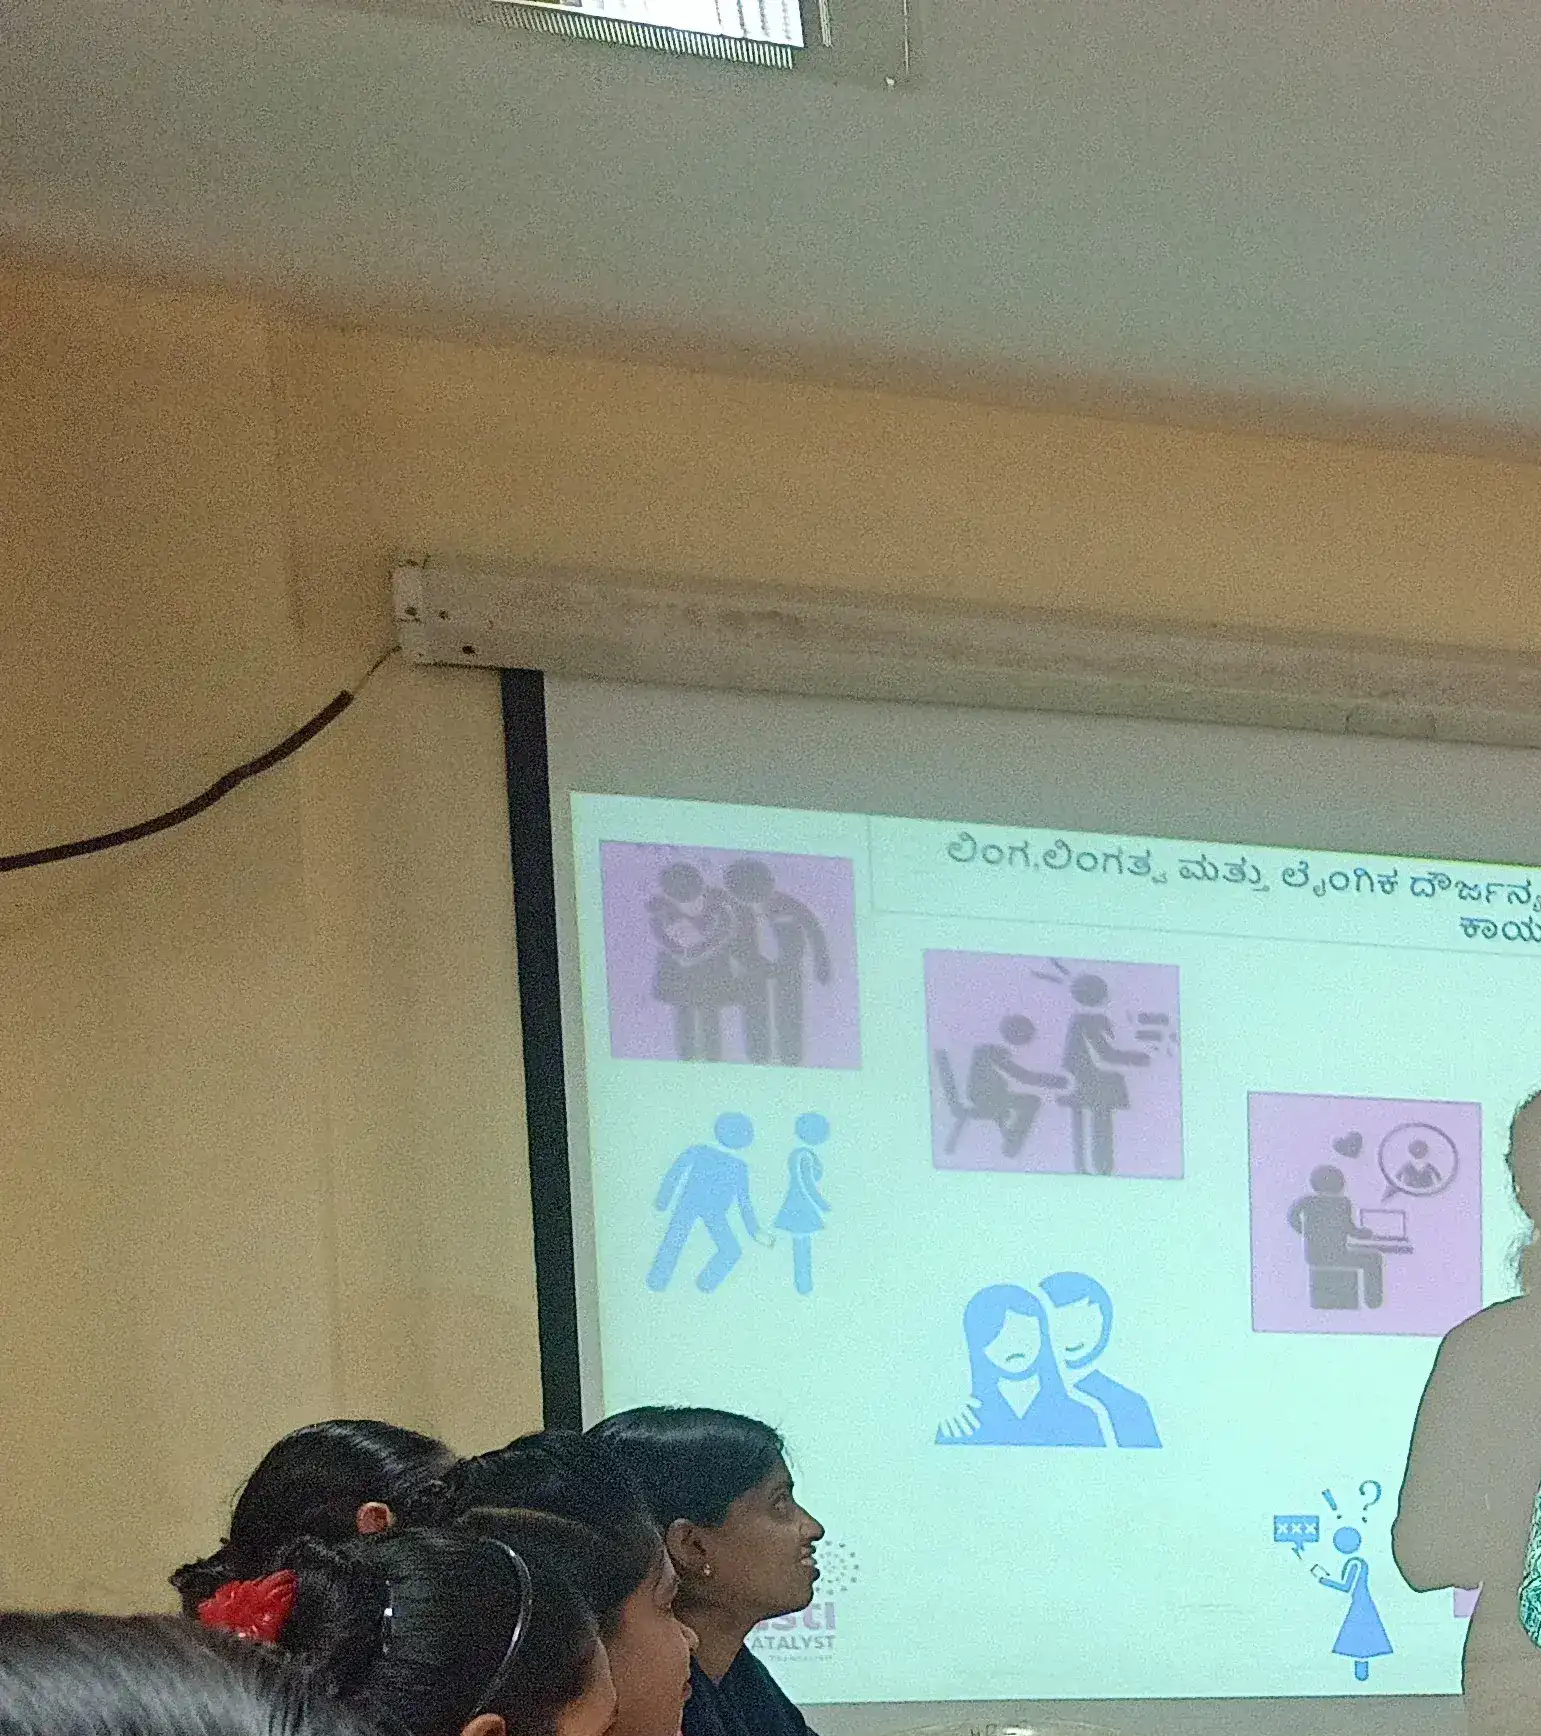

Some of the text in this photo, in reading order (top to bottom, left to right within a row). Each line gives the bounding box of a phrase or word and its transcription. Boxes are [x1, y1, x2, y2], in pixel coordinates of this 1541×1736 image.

[1177, 853, 1270, 892] ಮತ್ತು
[1281, 860, 1401, 898] ಲೈಂಗಿಕ
[751, 1634, 837, 1650] ATALYST
